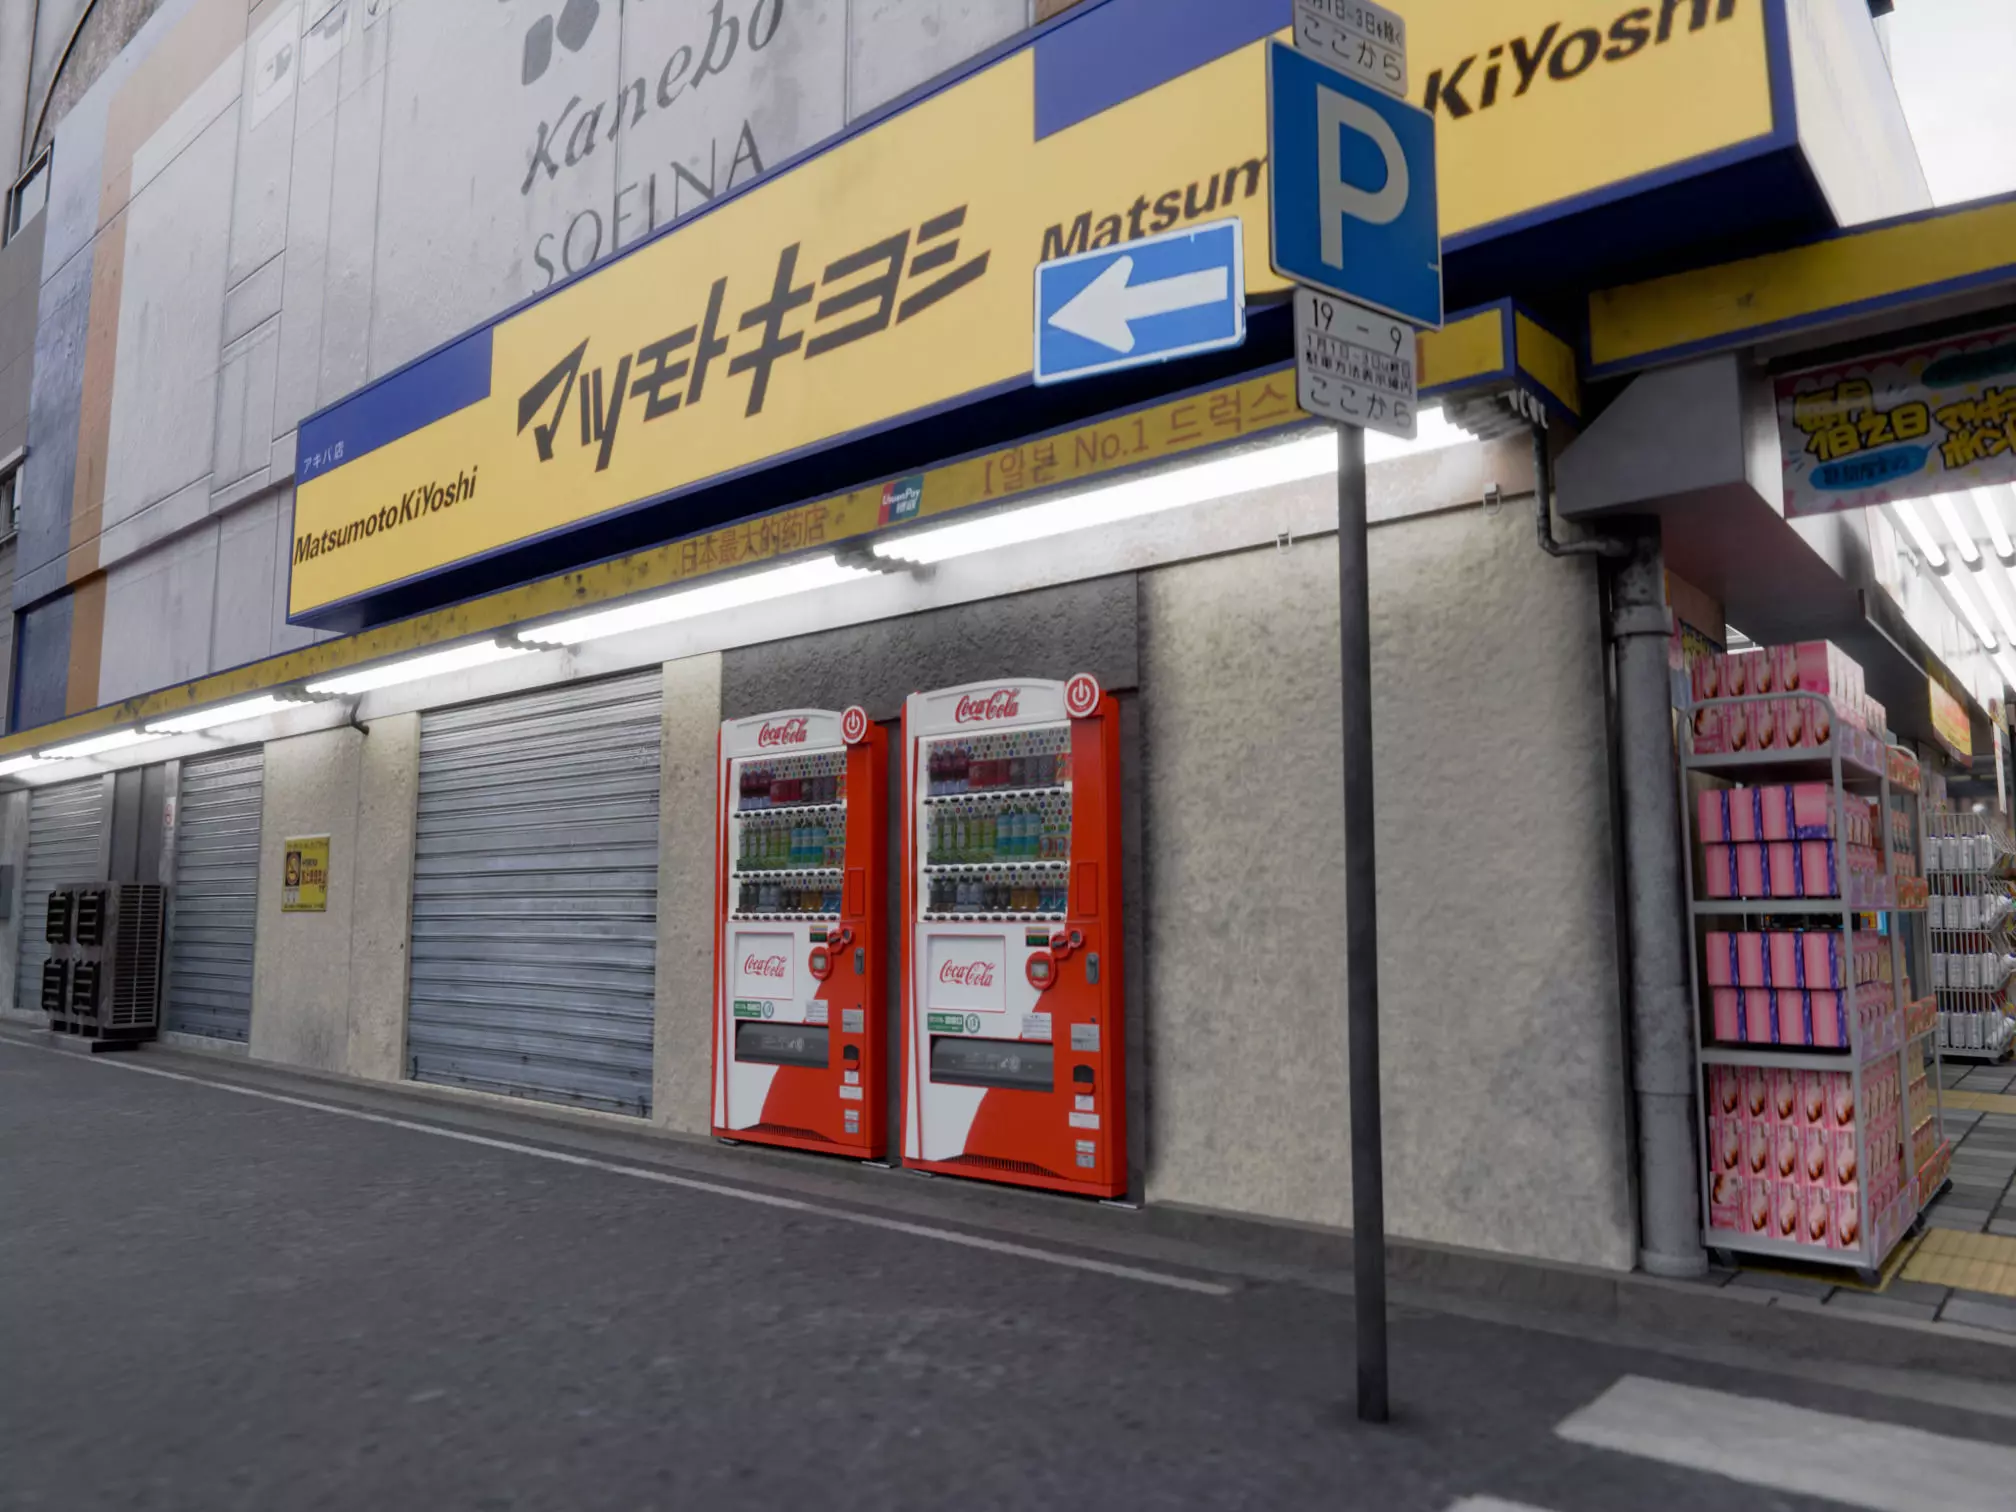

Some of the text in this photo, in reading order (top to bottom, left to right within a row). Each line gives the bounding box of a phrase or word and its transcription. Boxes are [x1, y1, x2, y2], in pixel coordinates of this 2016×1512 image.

[1304, 14, 1402, 82] ここから
[521, 0, 784, 196] Kanebo
[1317, 83, 1409, 270] P
[532, 118, 765, 295] SOFINA
[1312, 298, 1334, 332] 19
[1390, 326, 1403, 356] 9
[1311, 376, 1412, 430] ここから
[303, 441, 345, 474] アキバ店
[1074, 417, 1150, 469] No.1
[758, 717, 809, 748] Coca-Cola
[955, 688, 1021, 723] Coca-Cola
